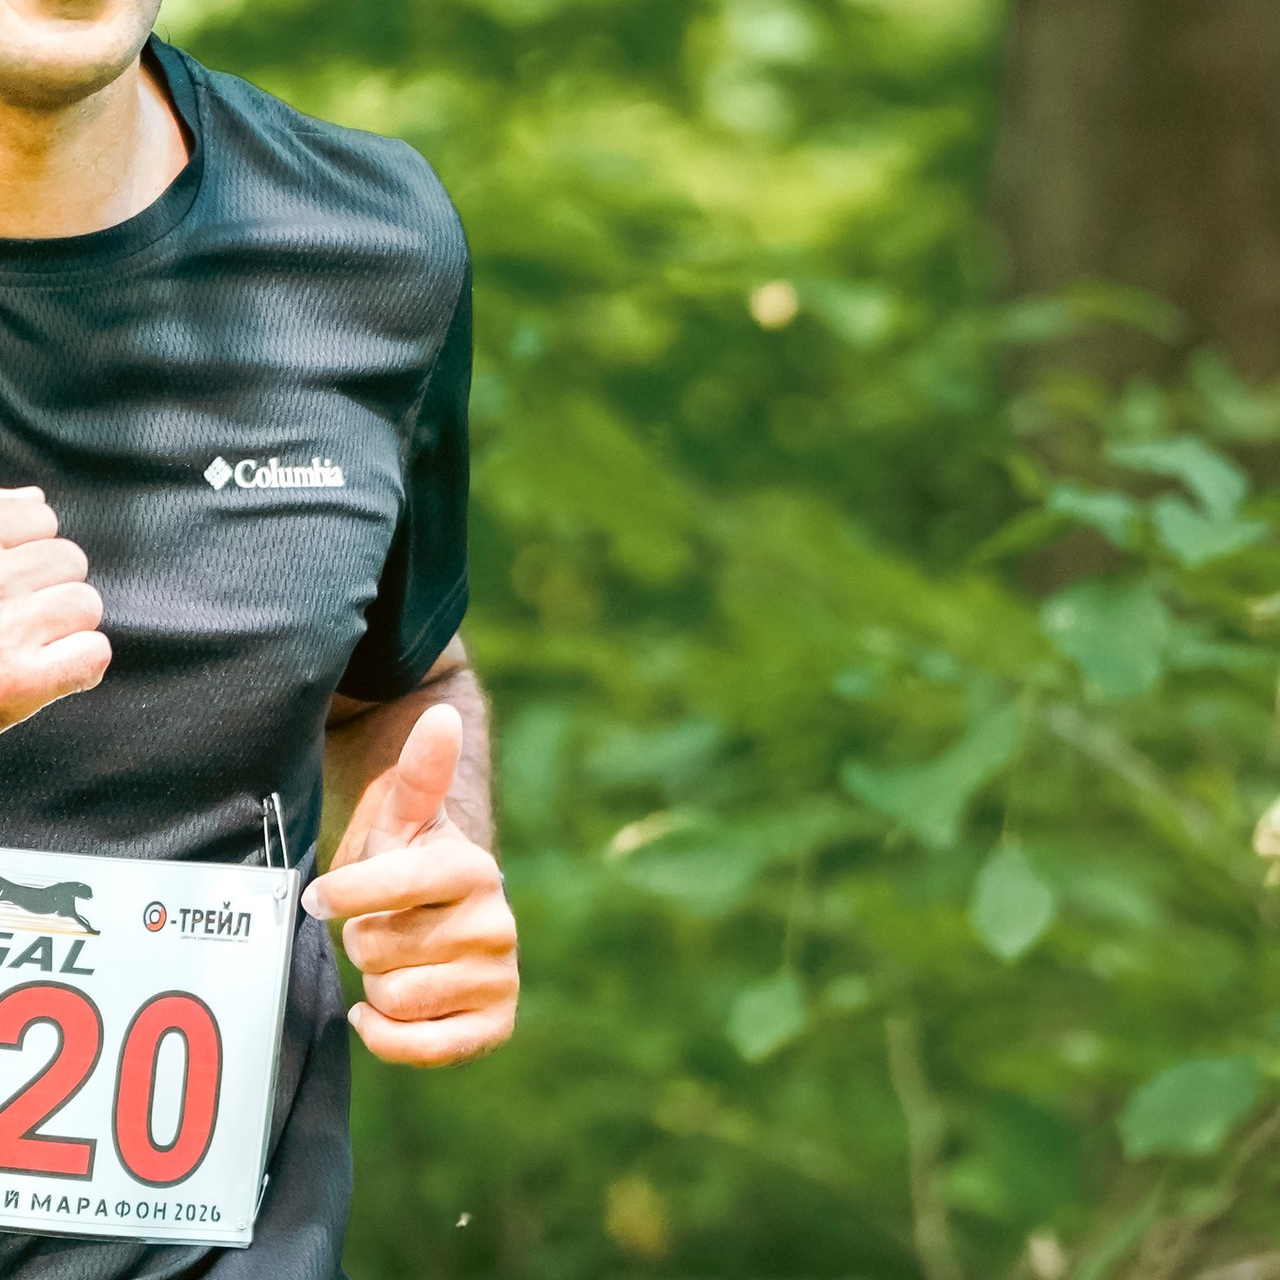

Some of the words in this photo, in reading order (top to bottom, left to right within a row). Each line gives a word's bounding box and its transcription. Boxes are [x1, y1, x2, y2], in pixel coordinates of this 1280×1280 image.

[234, 456, 344, 488] Columbia
[31, 1193, 167, 1220] МАРАФОН
[174, 1203, 221, 1222] 2026
